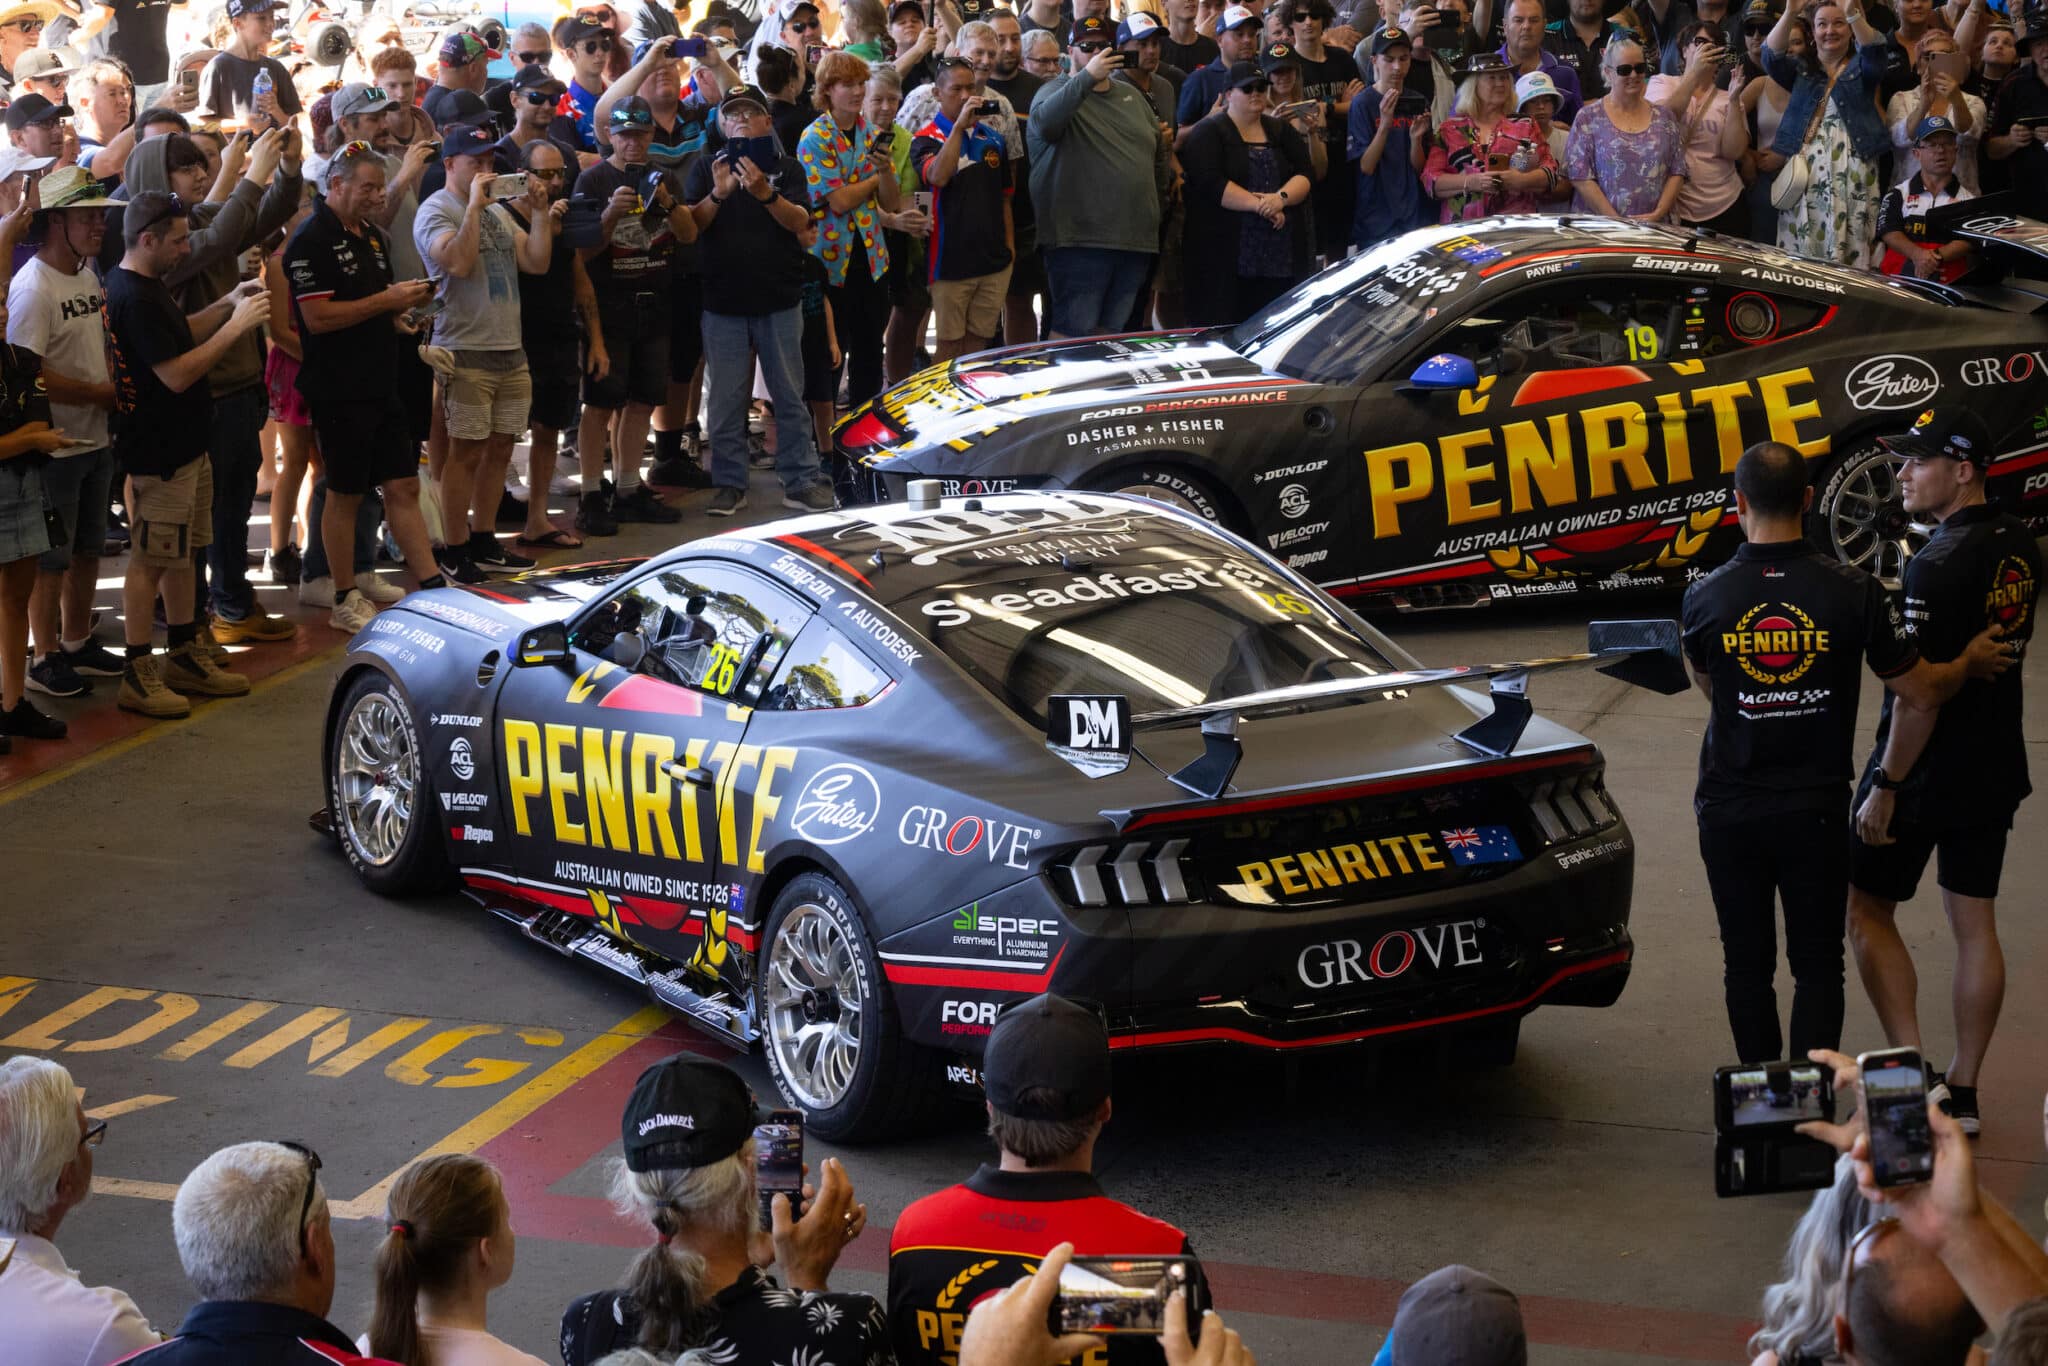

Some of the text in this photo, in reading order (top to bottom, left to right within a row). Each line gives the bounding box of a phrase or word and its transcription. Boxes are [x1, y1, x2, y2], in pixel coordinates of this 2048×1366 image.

[1526, 263, 1562, 279] PAYNE
[1761, 270, 1846, 295] AUTODESK
[1624, 325, 1658, 361] 19
[1853, 361, 1937, 410] Gates
[1080, 390, 1289, 422] FORD PERFORMANCE
[1067, 425, 1138, 447] DASHER
[1162, 418, 1225, 432] FISHER
[1095, 436, 1206, 455] TASMANIAN GIN
[1363, 366, 1832, 541] PENRITE
[1264, 460, 1329, 481] DUNLOP
[1280, 493, 1311, 511] ACL
[1280, 521, 1330, 541] VELOCITY
[1434, 487, 1727, 558] AUSTRALIAN OWNED SINCE 1926
[973, 534, 1138, 560] AUSTRALIAN
[921, 566, 1223, 627] Steadfast
[1512, 579, 1577, 595] InfraBuild
[405, 629, 447, 654] FISHER
[854, 607, 923, 666] AUTODESK
[1722, 630, 1830, 655] PENRITE
[702, 643, 742, 696] 26
[1739, 691, 1799, 705] RACING
[439, 715, 483, 727] DUNLOP
[1069, 700, 1120, 750] D&M
[450, 752, 475, 766] ACL
[453, 793, 488, 806] VELOCITY
[504, 718, 799, 875] PENRITE
[464, 825, 494, 844] Repco
[899, 805, 1033, 870] GROVE
[1236, 832, 1447, 902] PENRITE
[554, 860, 729, 904] AUSTRALIAN OWNED SINCE 1926
[825, 895, 871, 998] DUNLOP
[953, 935, 1048, 950] EVERYTHING ALUMINIUM
[1012, 949, 1049, 959] HARDWARE
[1297, 920, 1485, 989] GROVE
[941, 1023, 993, 1036] PERFORM
